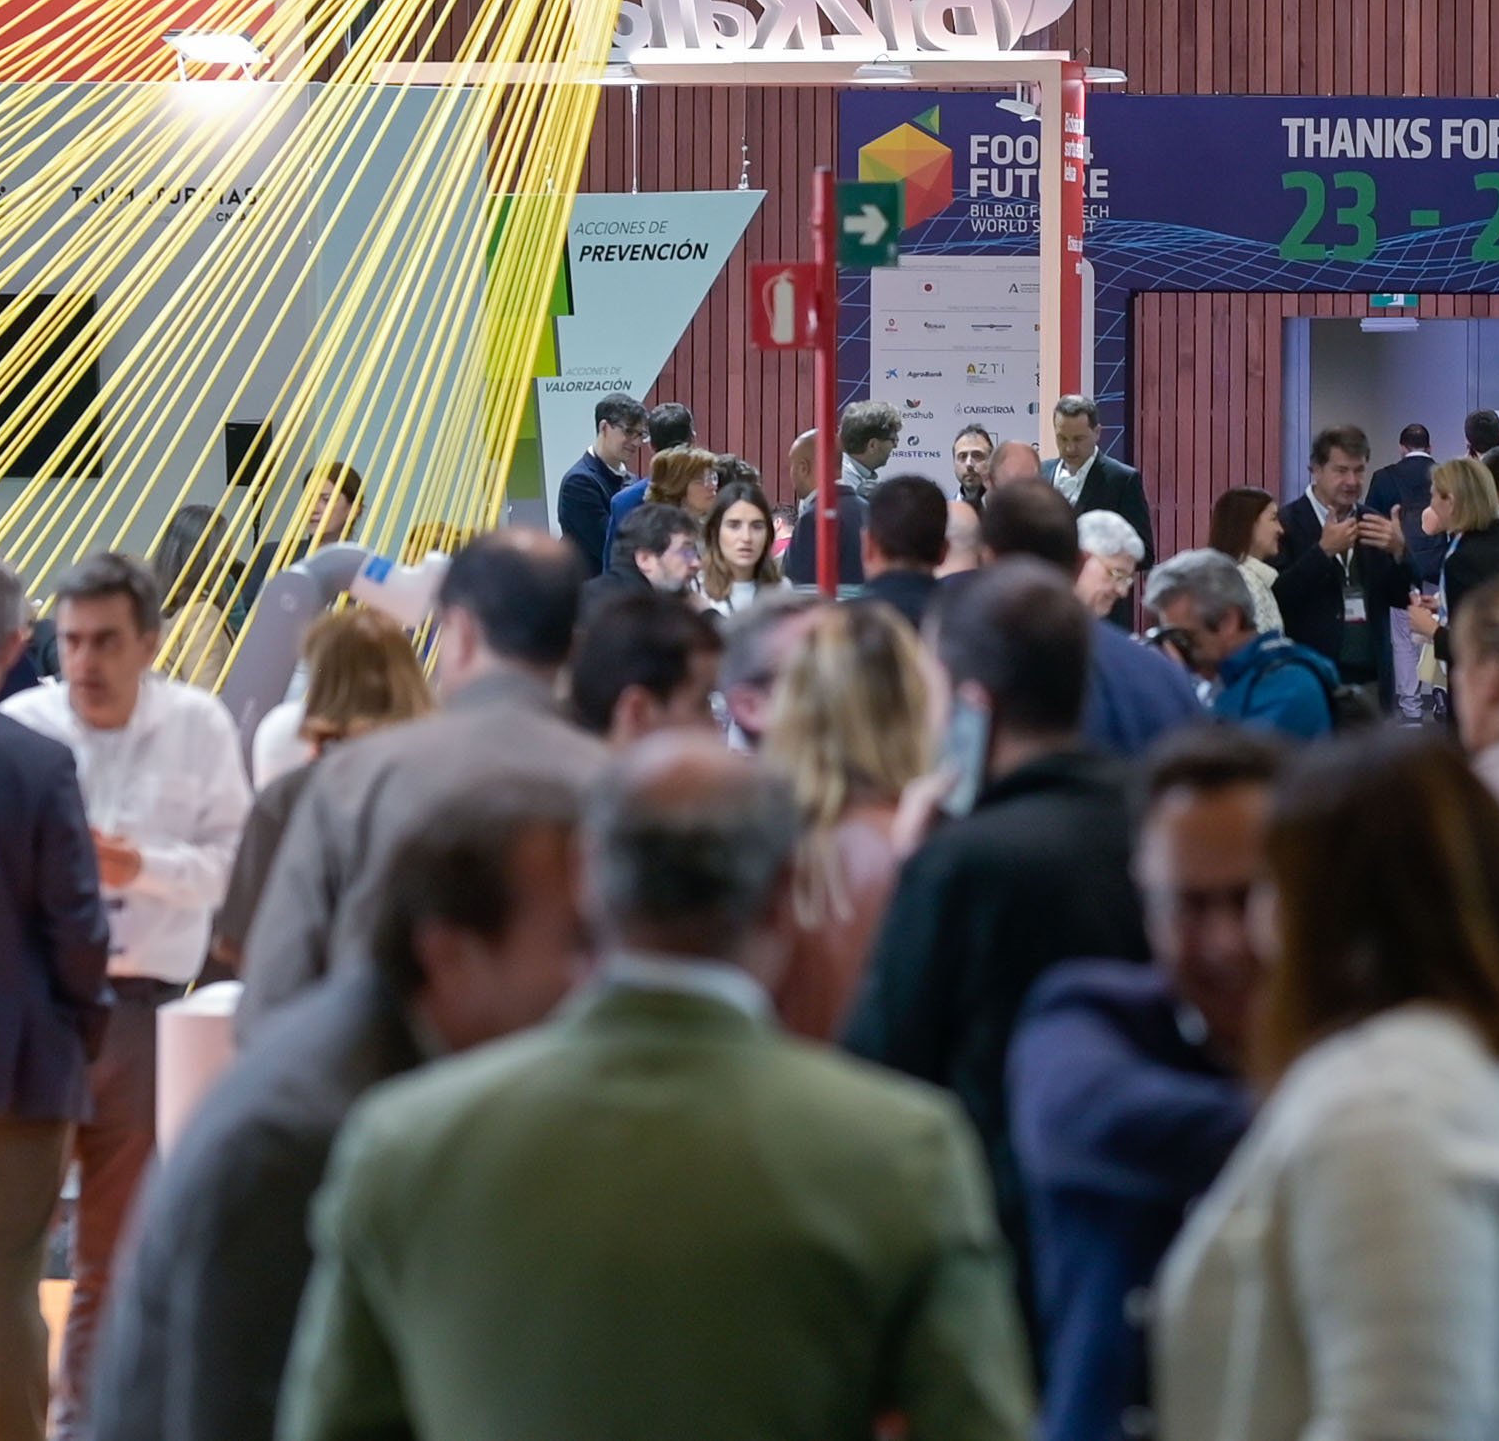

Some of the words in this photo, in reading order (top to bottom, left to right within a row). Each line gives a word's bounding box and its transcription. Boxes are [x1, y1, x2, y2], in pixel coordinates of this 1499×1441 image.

[1281, 118, 1431, 160] THANKS
[970, 135, 1042, 165] FOO
[970, 168, 1108, 198] FUTE
[971, 205, 1025, 218] BILBAO
[1279, 172, 1378, 262] 23
[1409, 209, 1441, 227] -
[574, 221, 646, 236] ACCIONES
[648, 220, 669, 234] DE
[971, 219, 1028, 232] WORLD
[578, 237, 709, 262] PREVENCIÓN
[544, 378, 633, 393] VALORIZACIÓN
[901, 409, 934, 420] endhub
